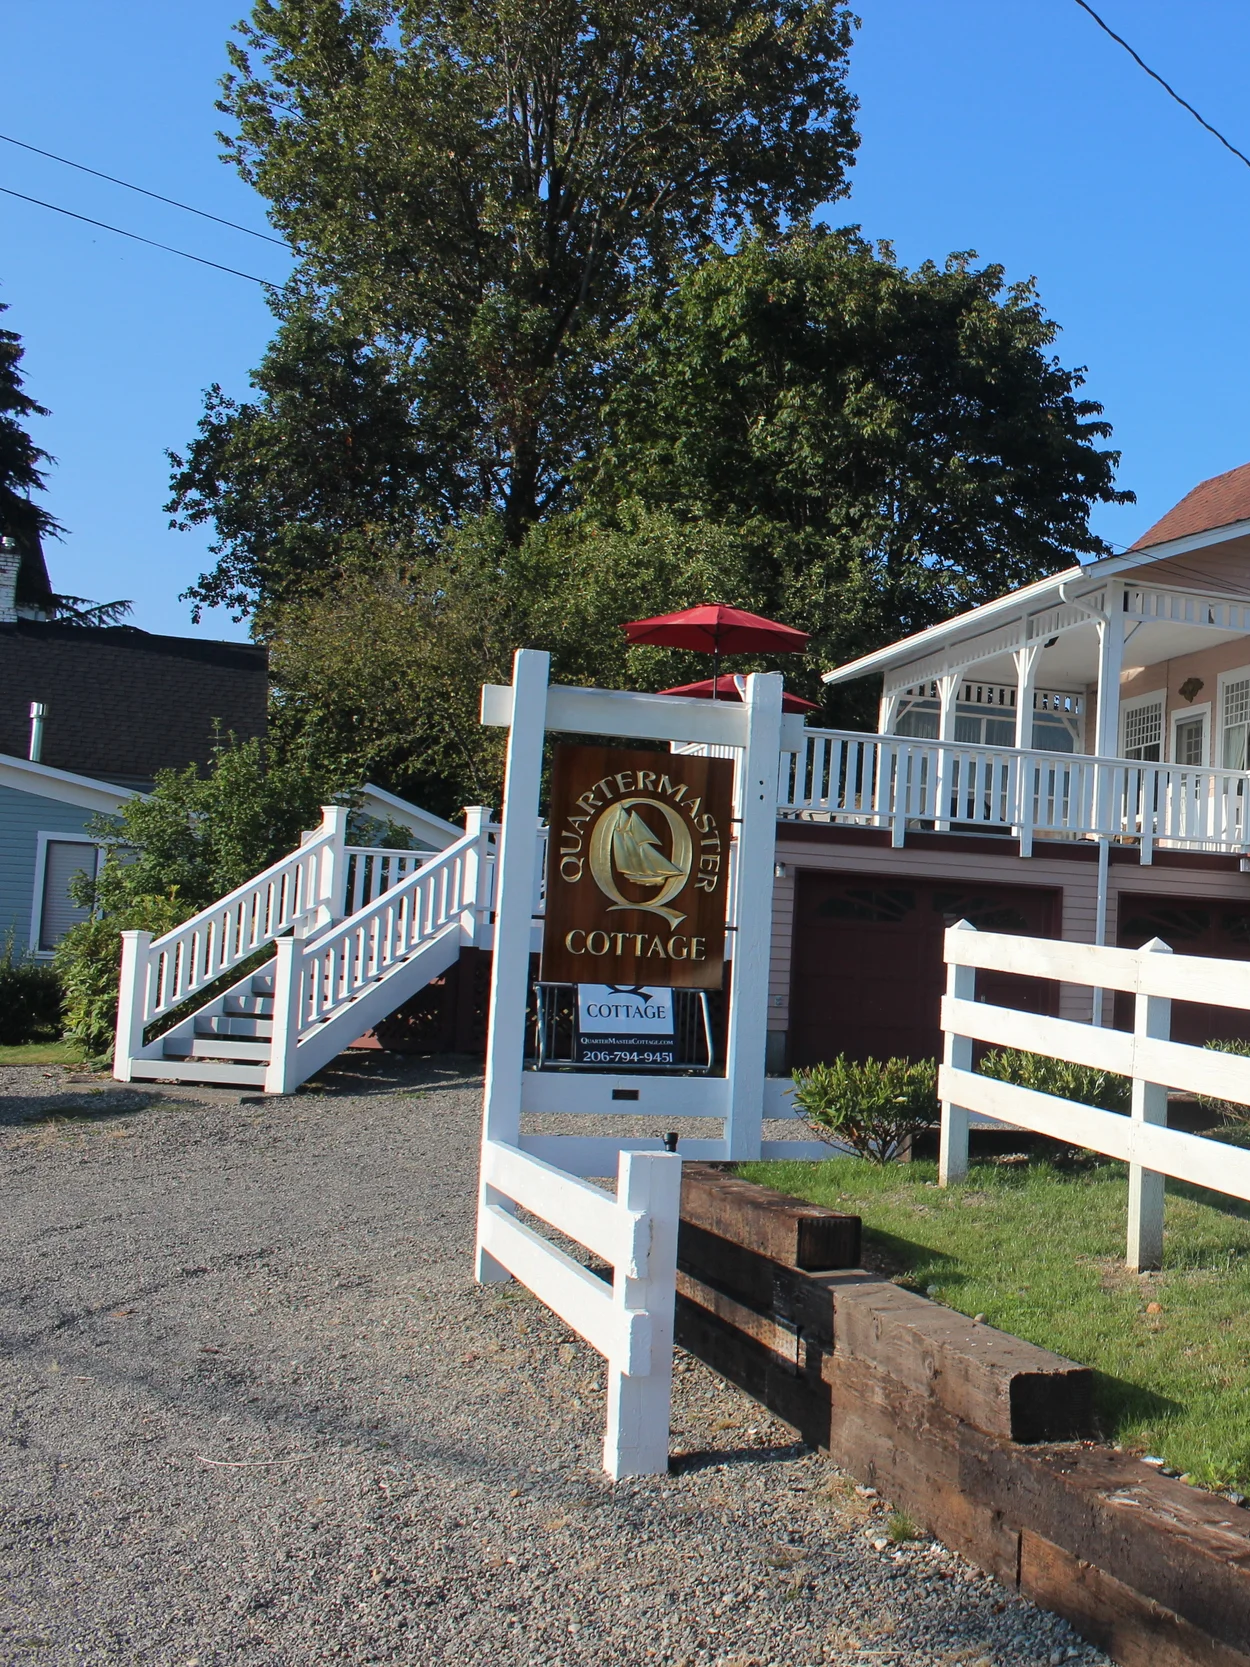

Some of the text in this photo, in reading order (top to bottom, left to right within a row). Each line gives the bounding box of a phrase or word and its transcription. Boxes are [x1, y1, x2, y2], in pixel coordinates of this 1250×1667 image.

[560, 770, 721, 893] QUARTERMASTER
[588, 797, 692, 931] Q
[565, 929, 706, 961] COTTAGE
[586, 1003, 667, 1020] COTTAGE
[582, 1050, 673, 1063] 206-794-9451
